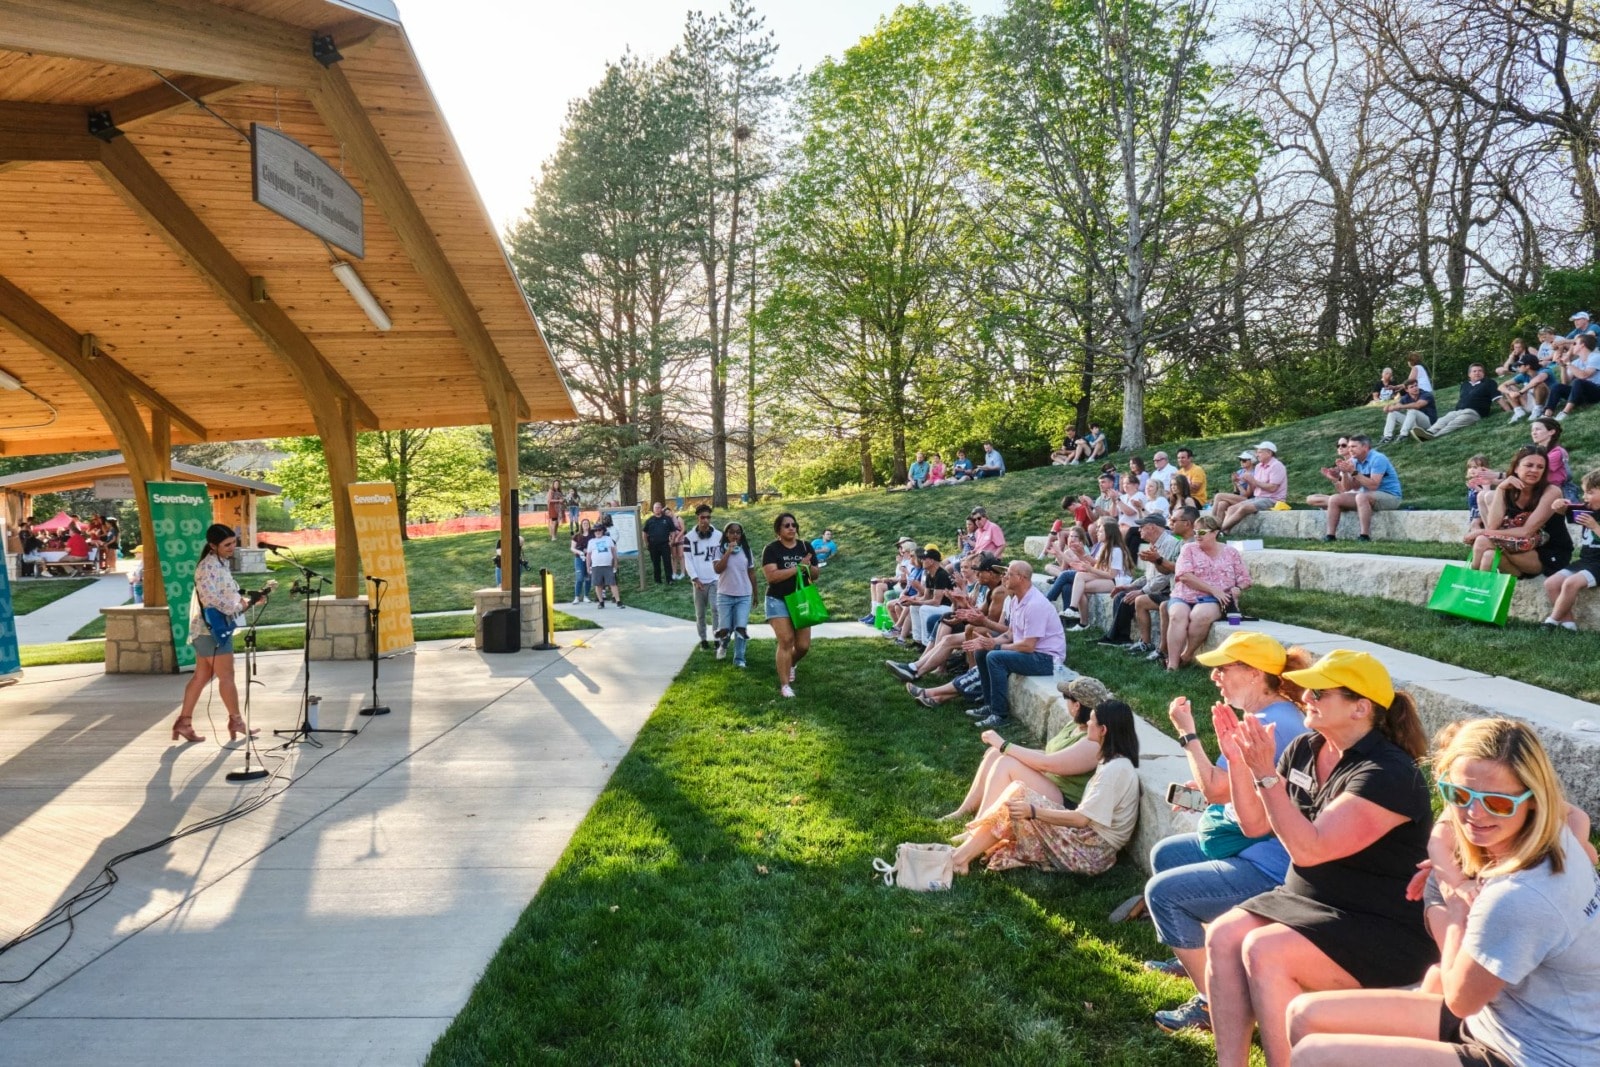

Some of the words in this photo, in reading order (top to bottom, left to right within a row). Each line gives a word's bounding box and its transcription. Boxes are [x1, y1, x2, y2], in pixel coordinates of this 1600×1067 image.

[153, 493, 204, 506] SevenDays
[353, 494, 392, 505] SevenDays
[180, 519, 203, 537] go
[164, 539, 187, 557] go
